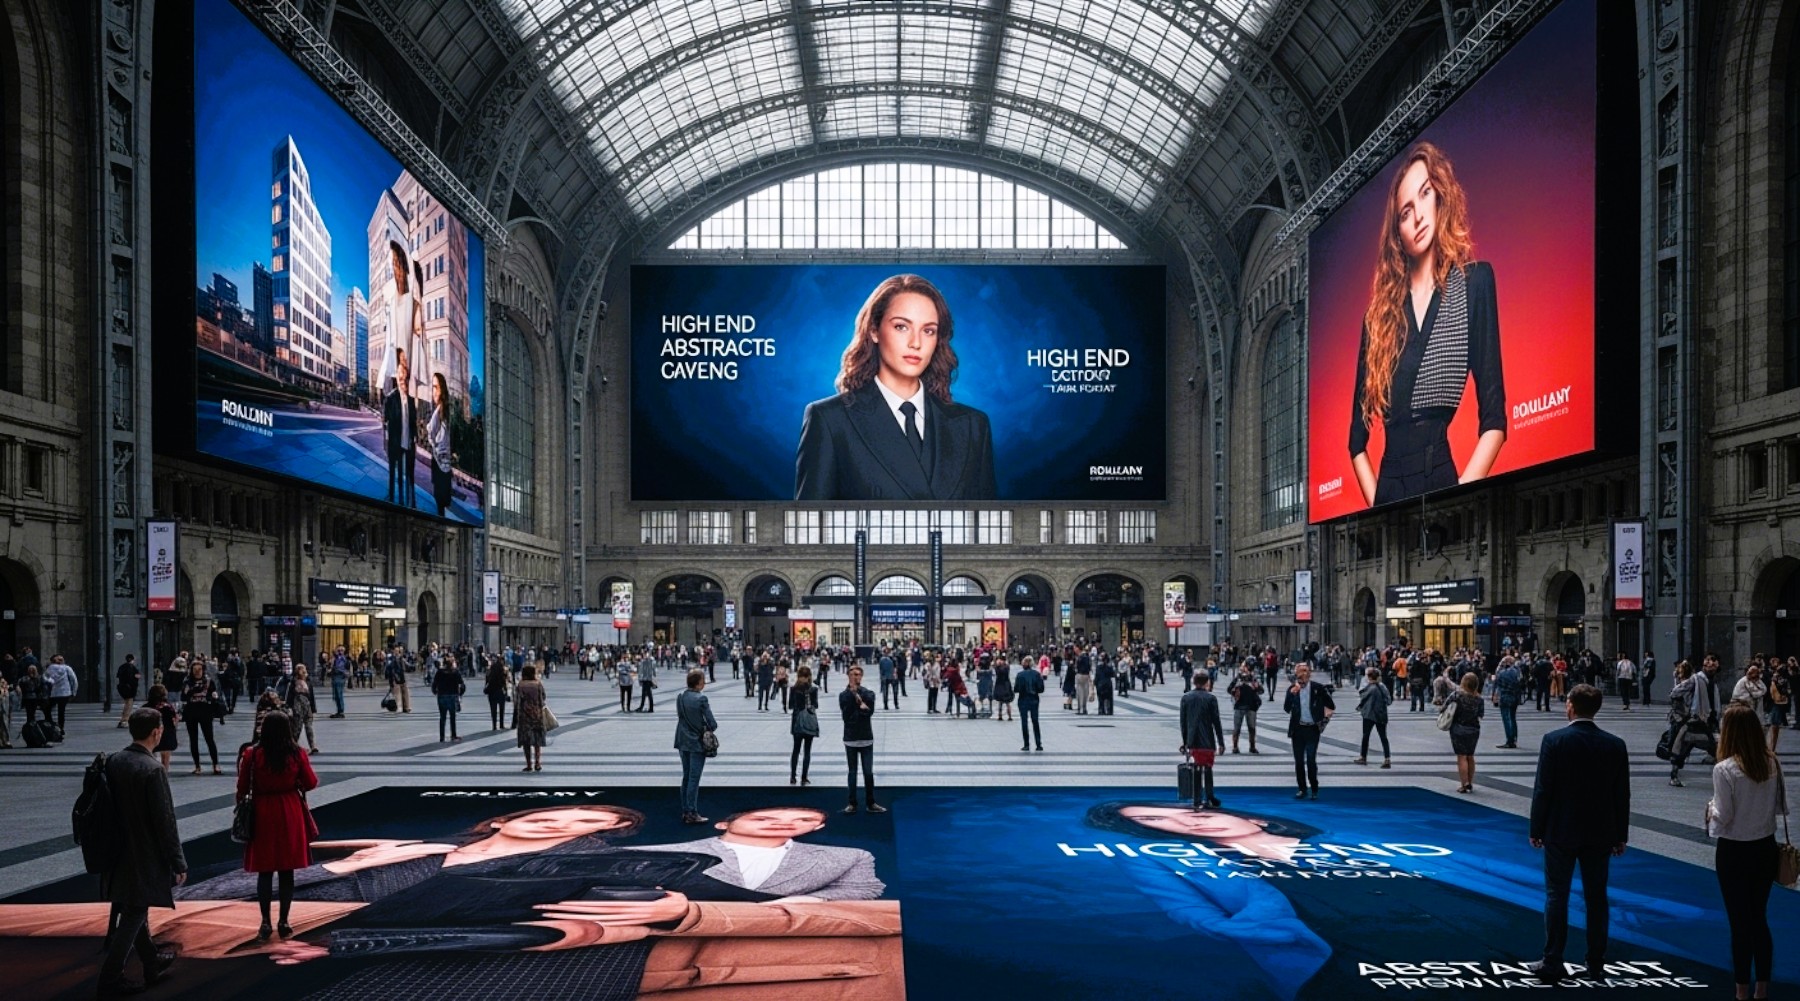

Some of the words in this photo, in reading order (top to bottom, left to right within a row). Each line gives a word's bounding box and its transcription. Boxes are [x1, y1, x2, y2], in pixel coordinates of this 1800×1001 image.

[661, 314, 710, 334] HIGH
[714, 314, 756, 334] END
[1027, 348, 1079, 368] HIGH
[1083, 348, 1131, 368] END
[660, 361, 738, 381] CAVENG
[1056, 842, 1258, 857] HIGH
[1266, 842, 1454, 857] END
